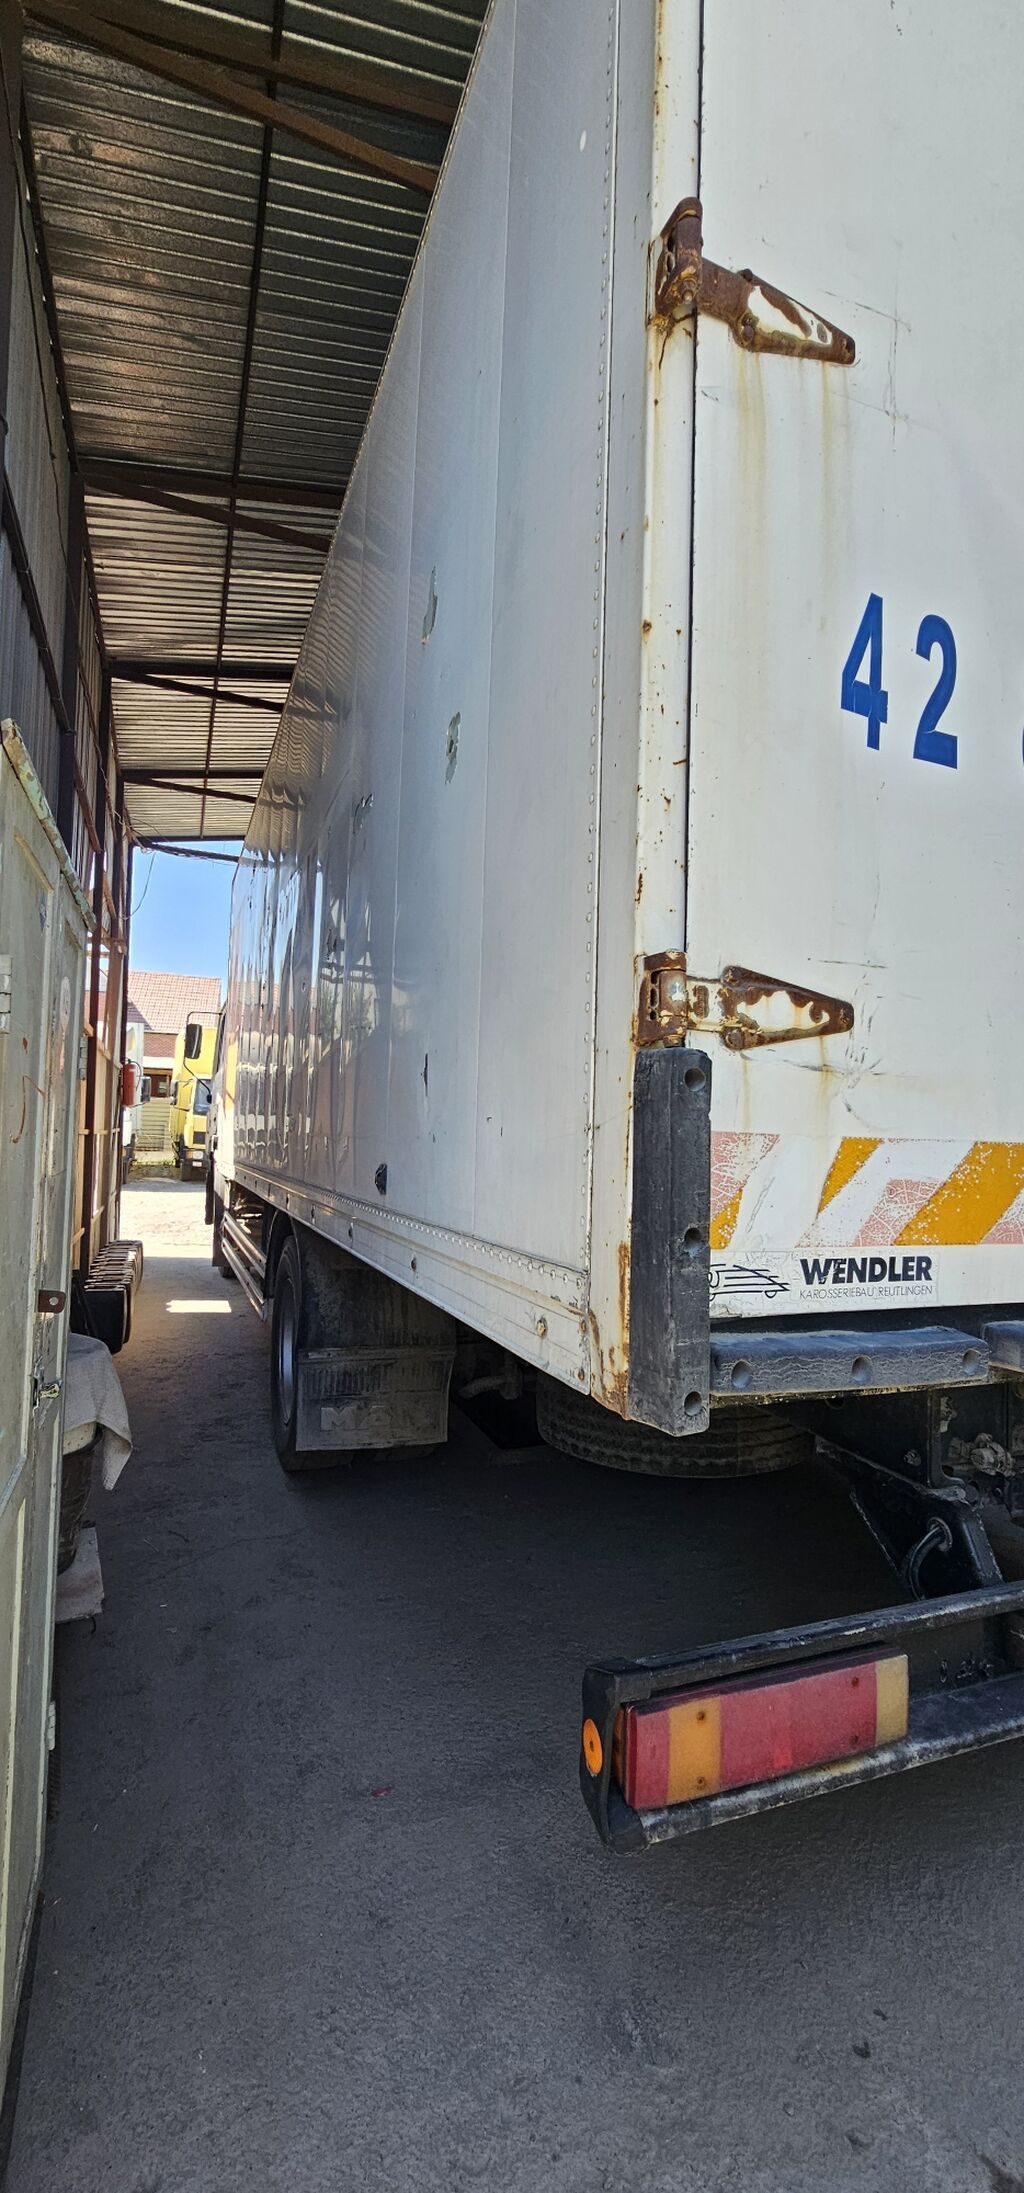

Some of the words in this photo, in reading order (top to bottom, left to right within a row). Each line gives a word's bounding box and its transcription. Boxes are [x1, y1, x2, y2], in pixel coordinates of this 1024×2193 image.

[800, 1256, 933, 1285] WENDLER
[800, 1286, 875, 1299] KAROSSERIEBAU
[879, 1285, 933, 1297] REUTLINGEN
